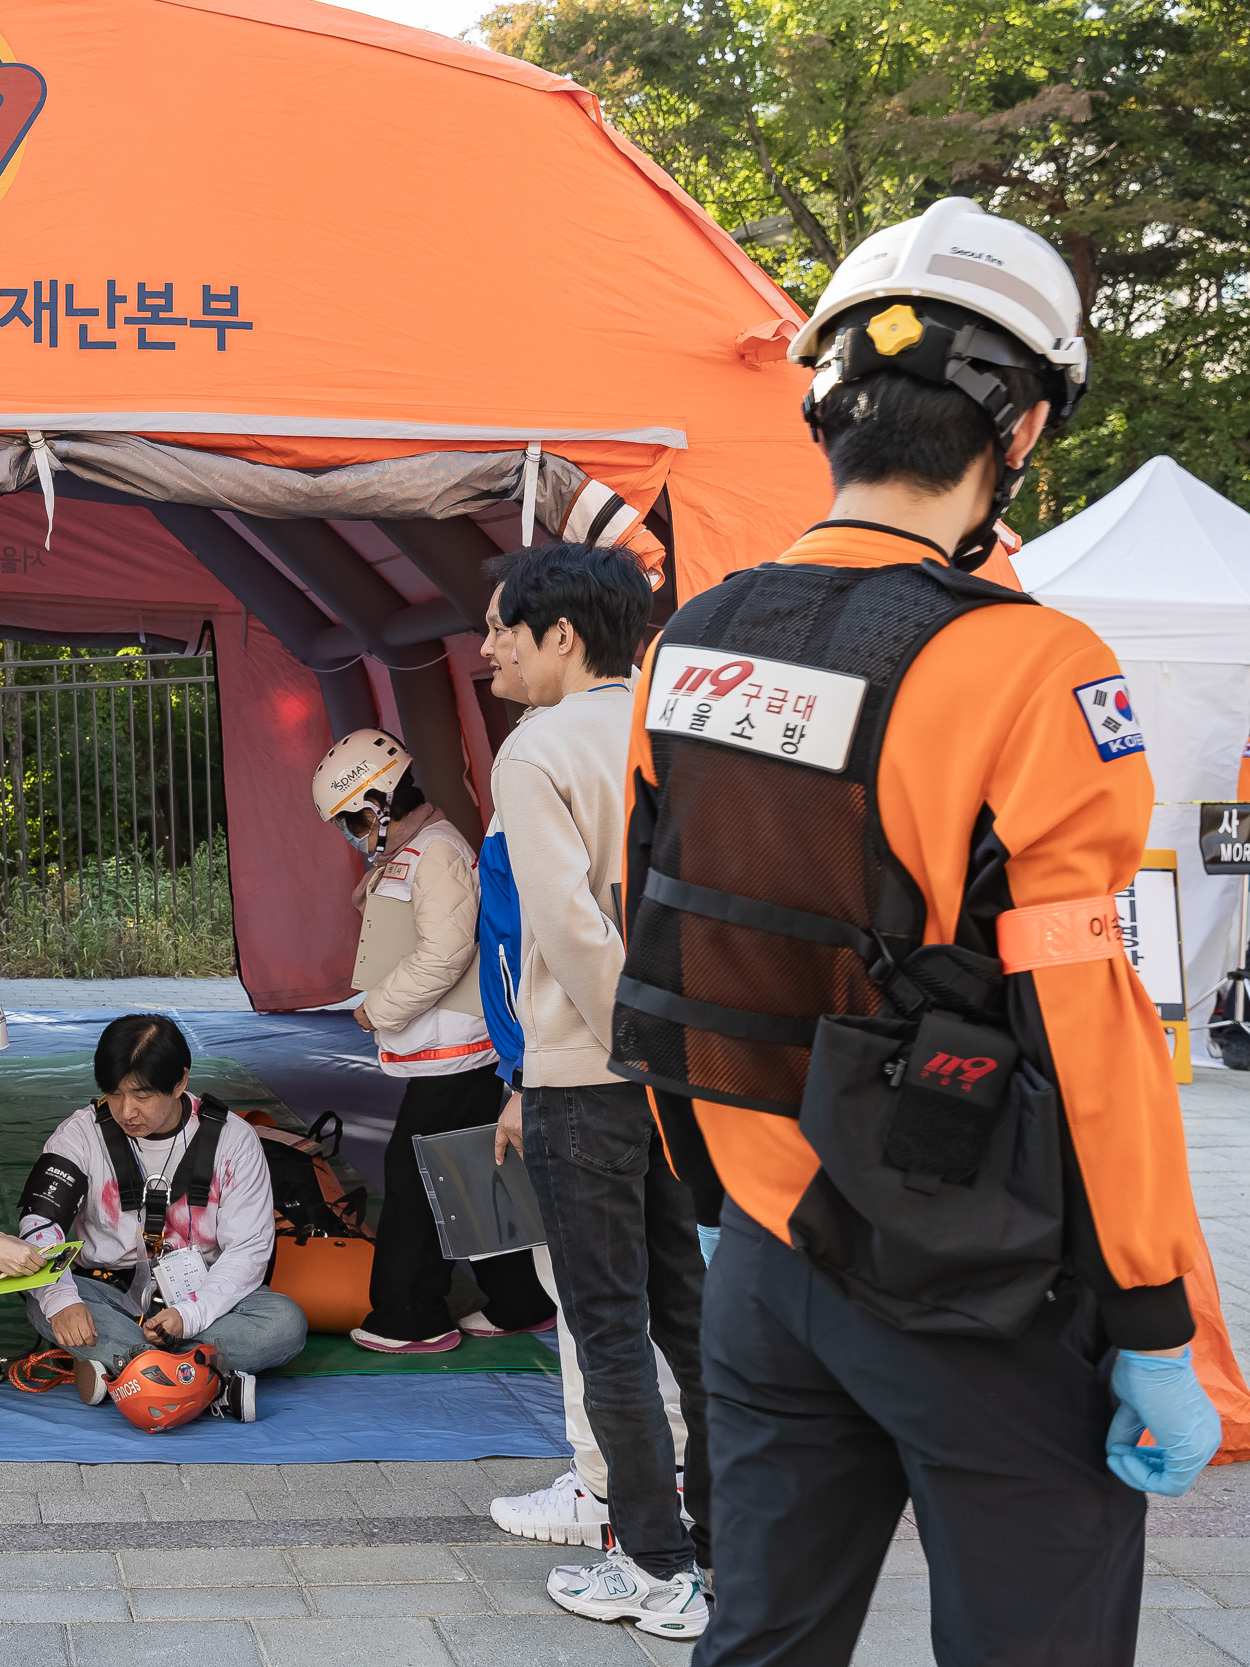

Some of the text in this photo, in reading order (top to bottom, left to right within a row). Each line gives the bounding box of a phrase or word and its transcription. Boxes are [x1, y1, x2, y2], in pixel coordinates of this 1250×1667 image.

[668, 660, 755, 702] 119
[336, 760, 369, 791] SDMAT
[923, 1051, 998, 1083] 119
